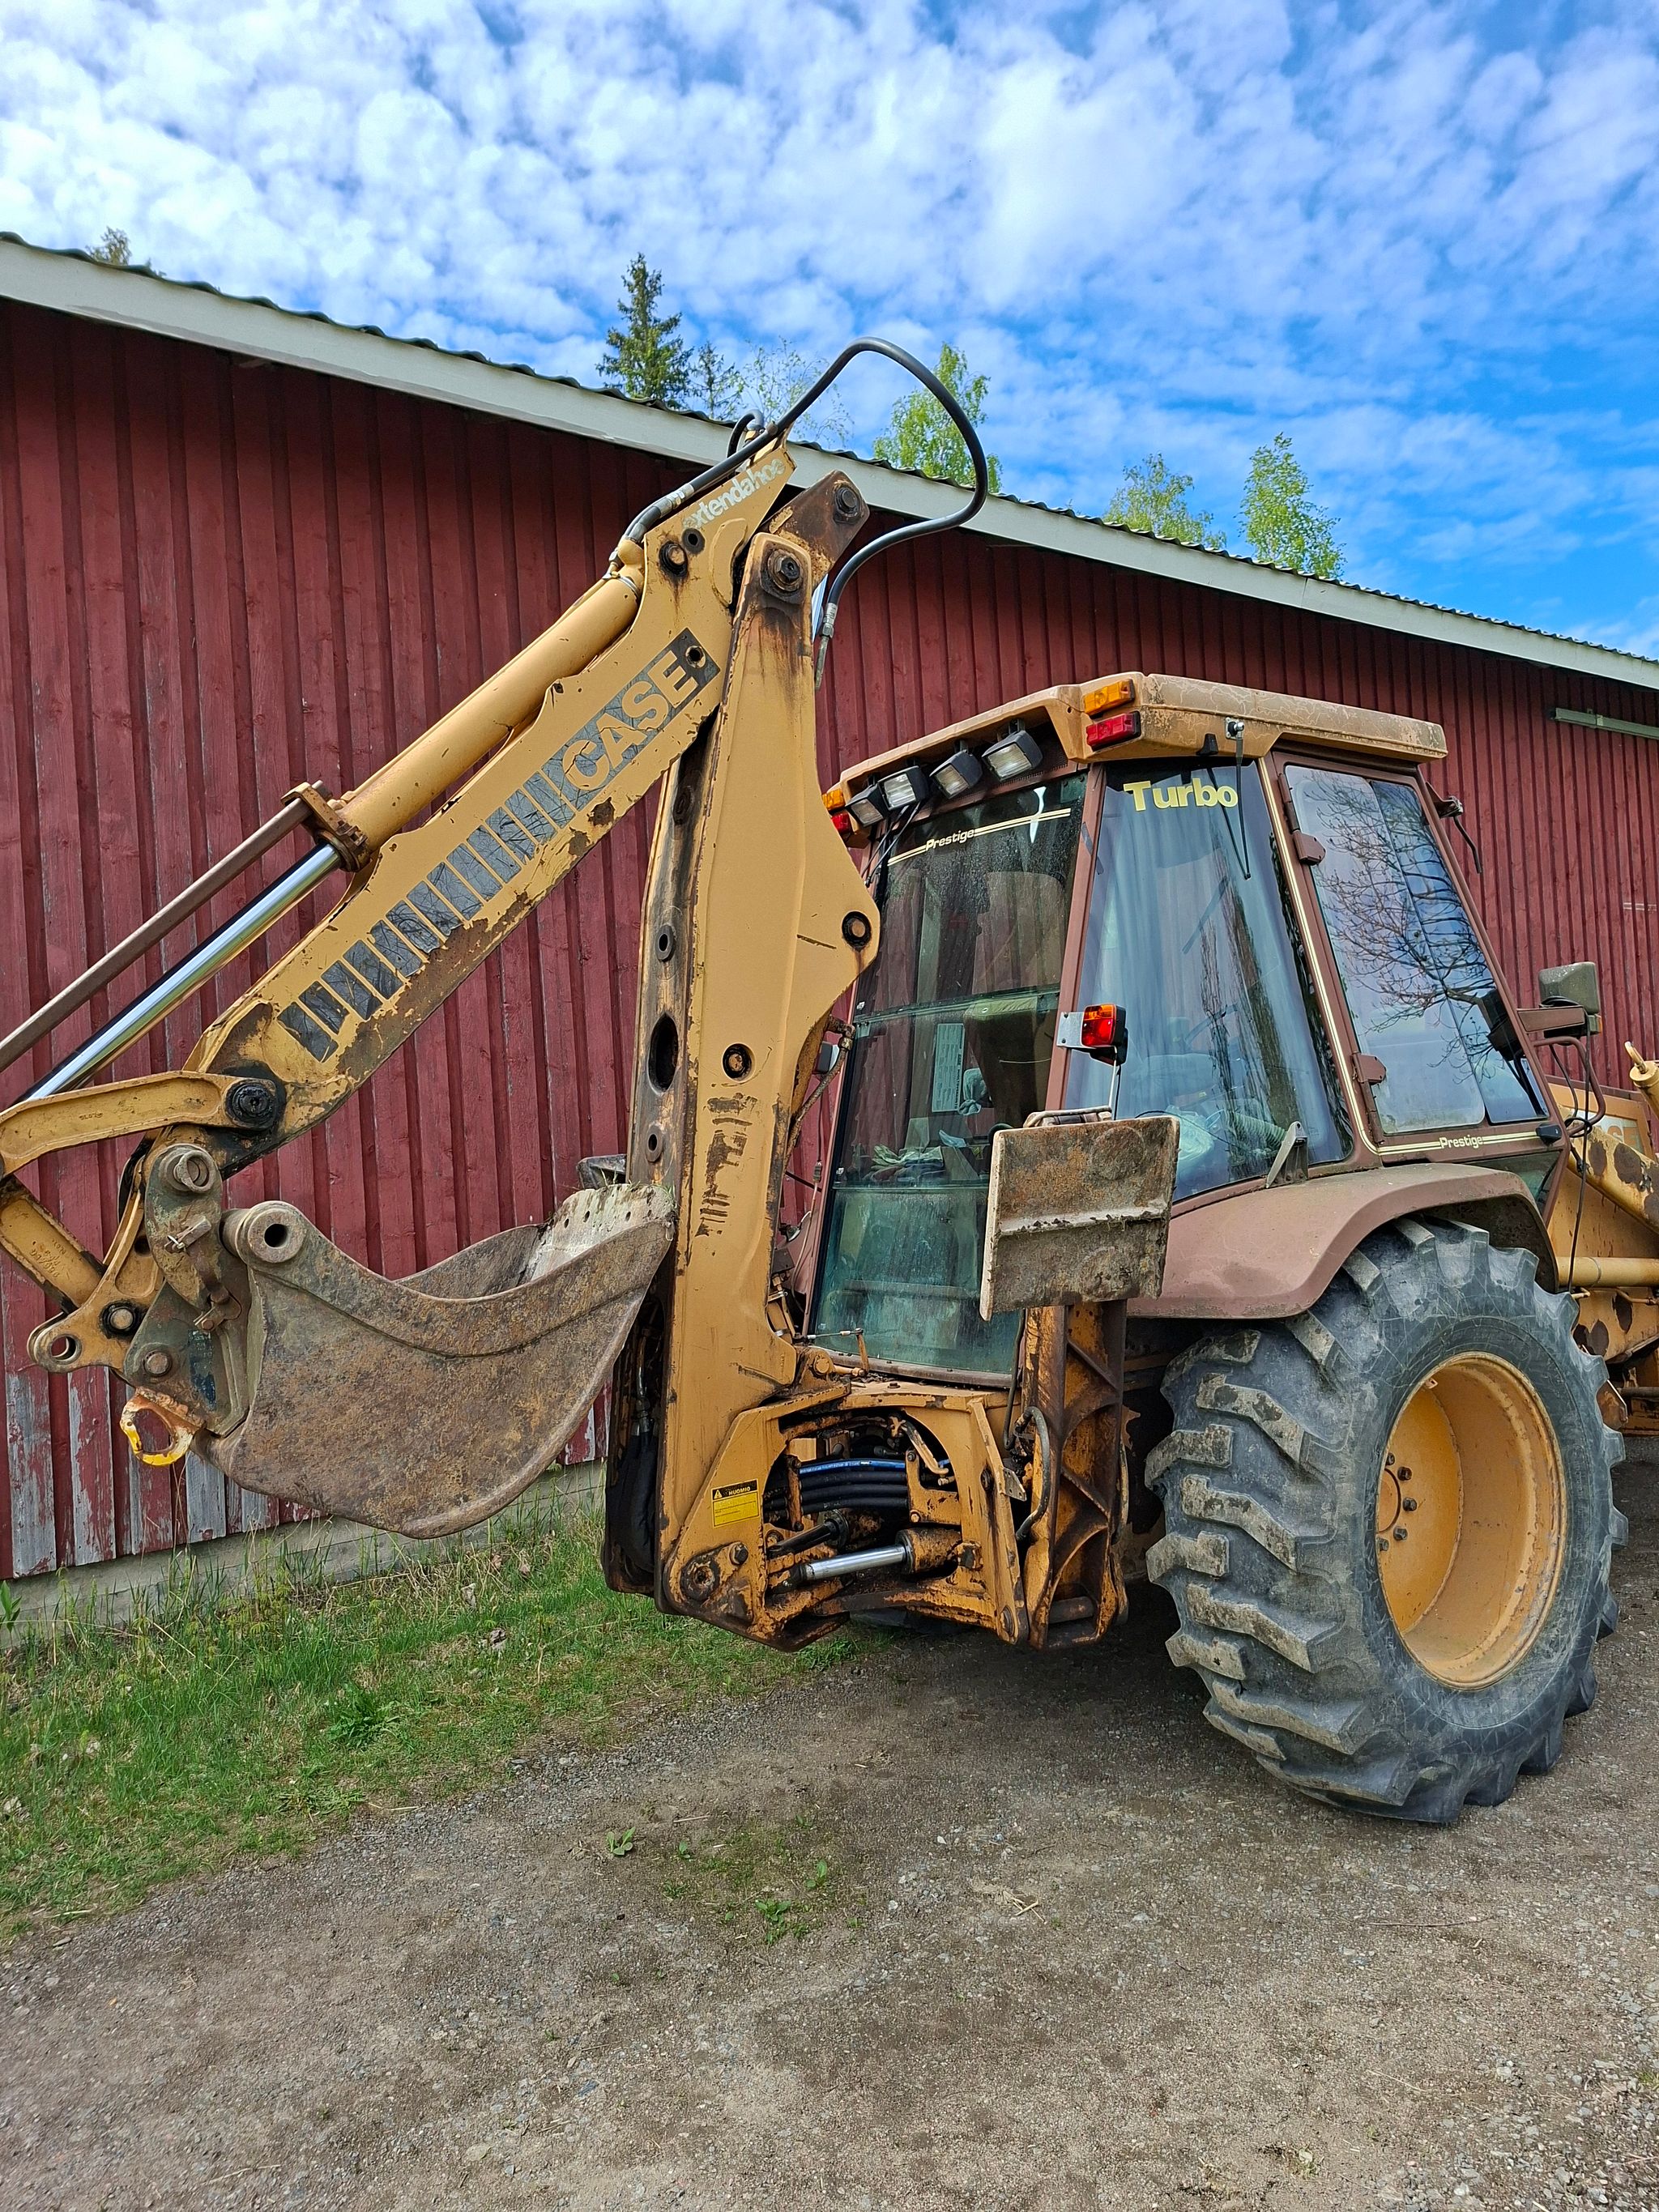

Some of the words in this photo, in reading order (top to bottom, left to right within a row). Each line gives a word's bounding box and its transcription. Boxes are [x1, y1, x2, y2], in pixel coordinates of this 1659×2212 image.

[682, 458, 786, 529] extendahoe
[563, 650, 699, 791] CASE
[1123, 778, 1239, 811] Turbo
[925, 829, 975, 851] Prestige
[1439, 1134, 1483, 1149] Prestige
